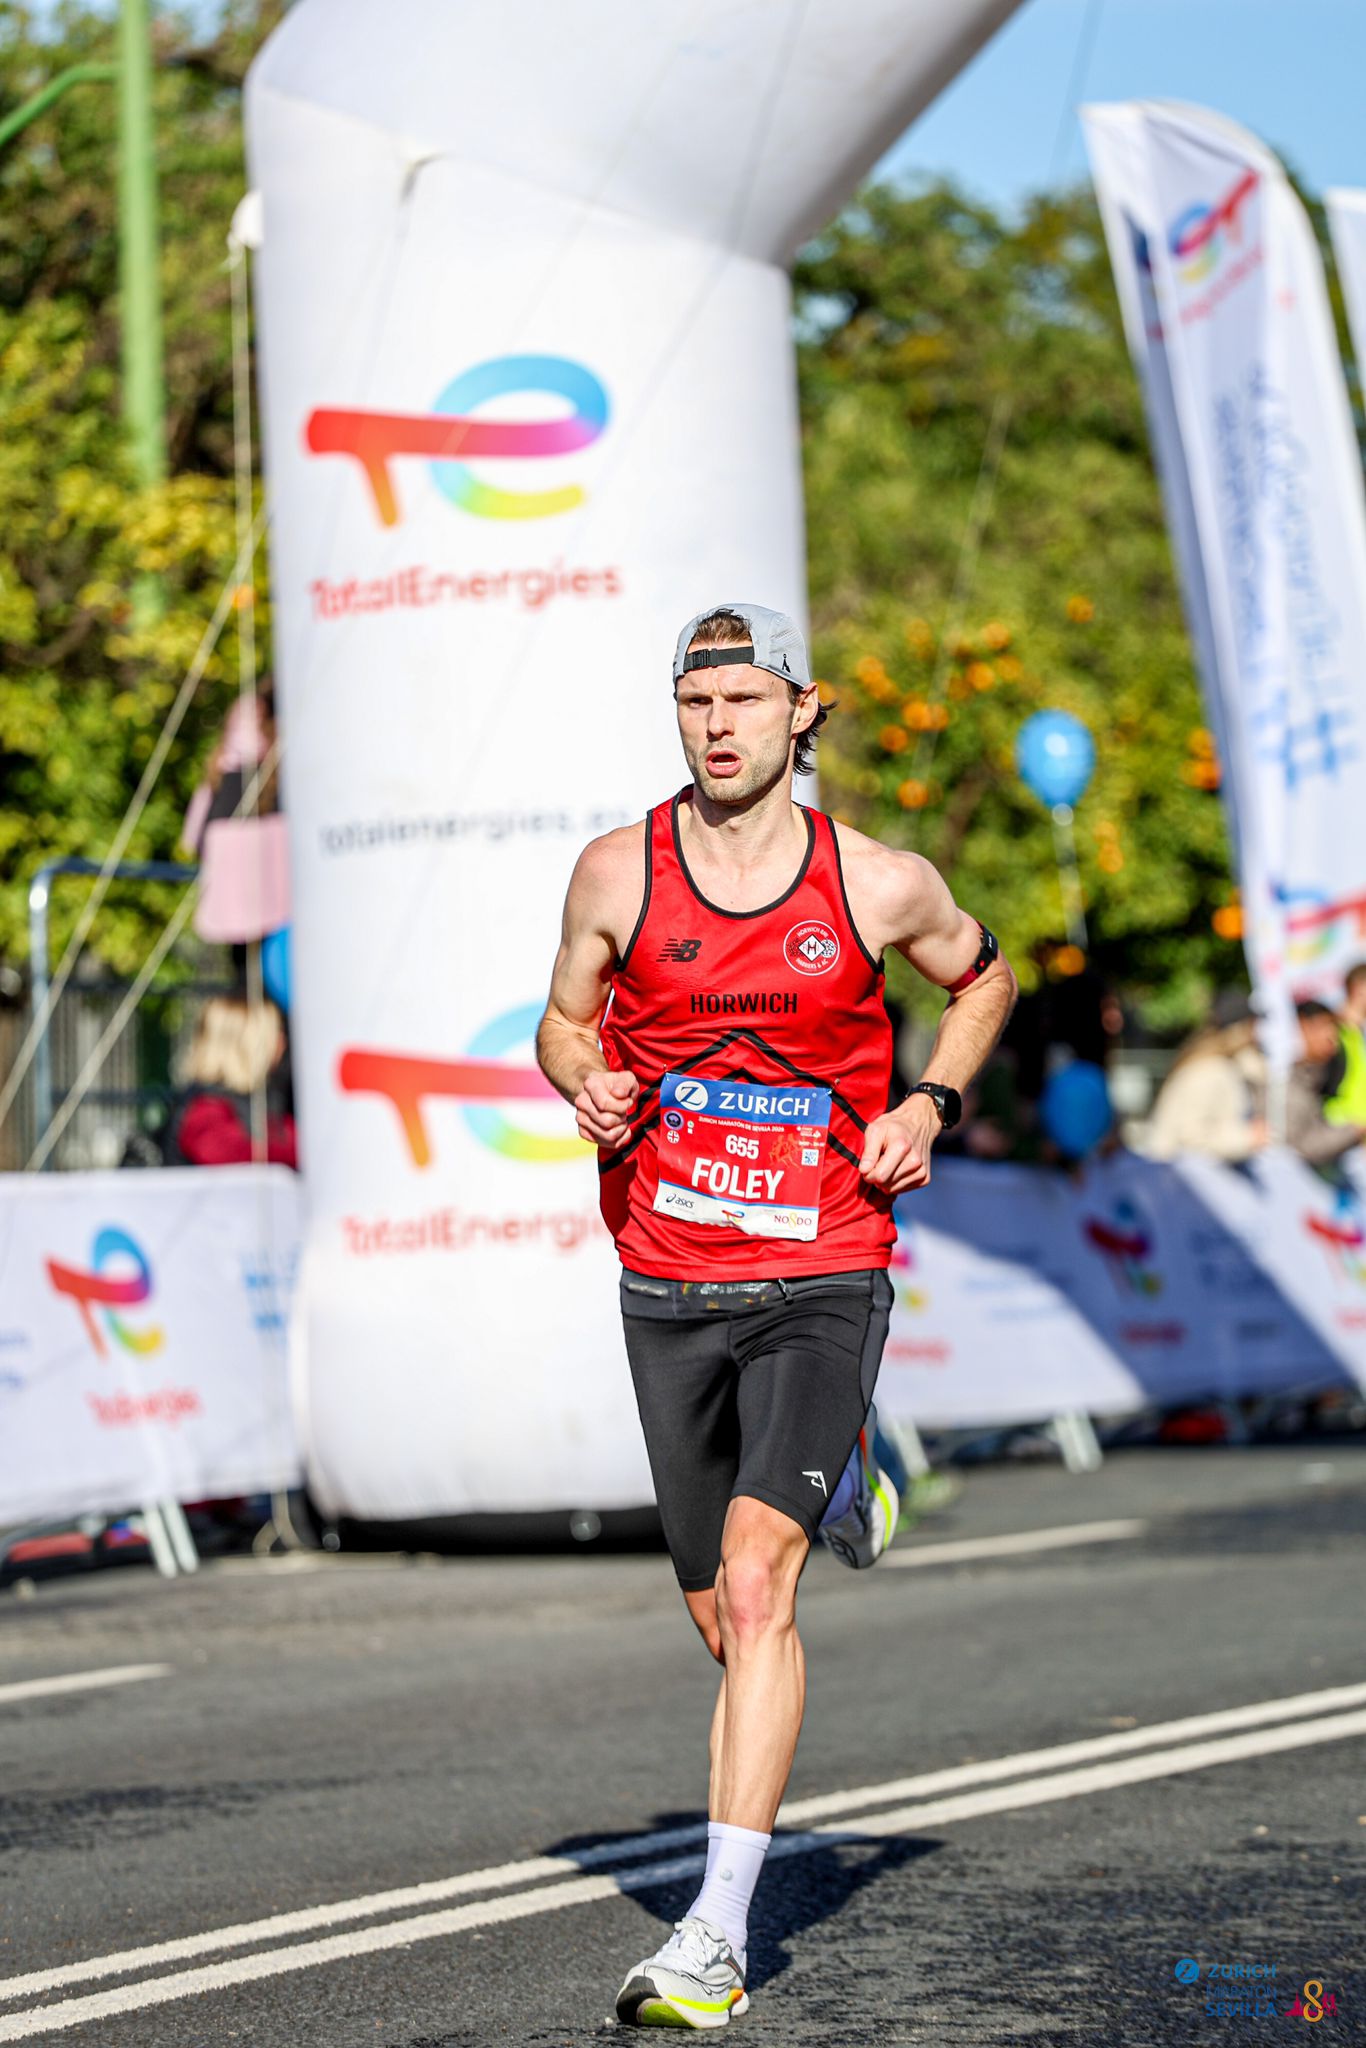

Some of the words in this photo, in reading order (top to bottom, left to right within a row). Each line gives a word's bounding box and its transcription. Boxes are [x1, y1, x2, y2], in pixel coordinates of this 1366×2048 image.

[309, 561, 622, 620] TotalEnergies
[690, 993, 797, 1014] HORWICH
[718, 1092, 810, 1117] ZURICH
[698, 1116, 717, 1125] ZURICH
[752, 1124, 770, 1132] SEVILLA
[725, 1134, 759, 1160] 655
[691, 1157, 785, 1200] FOLEY
